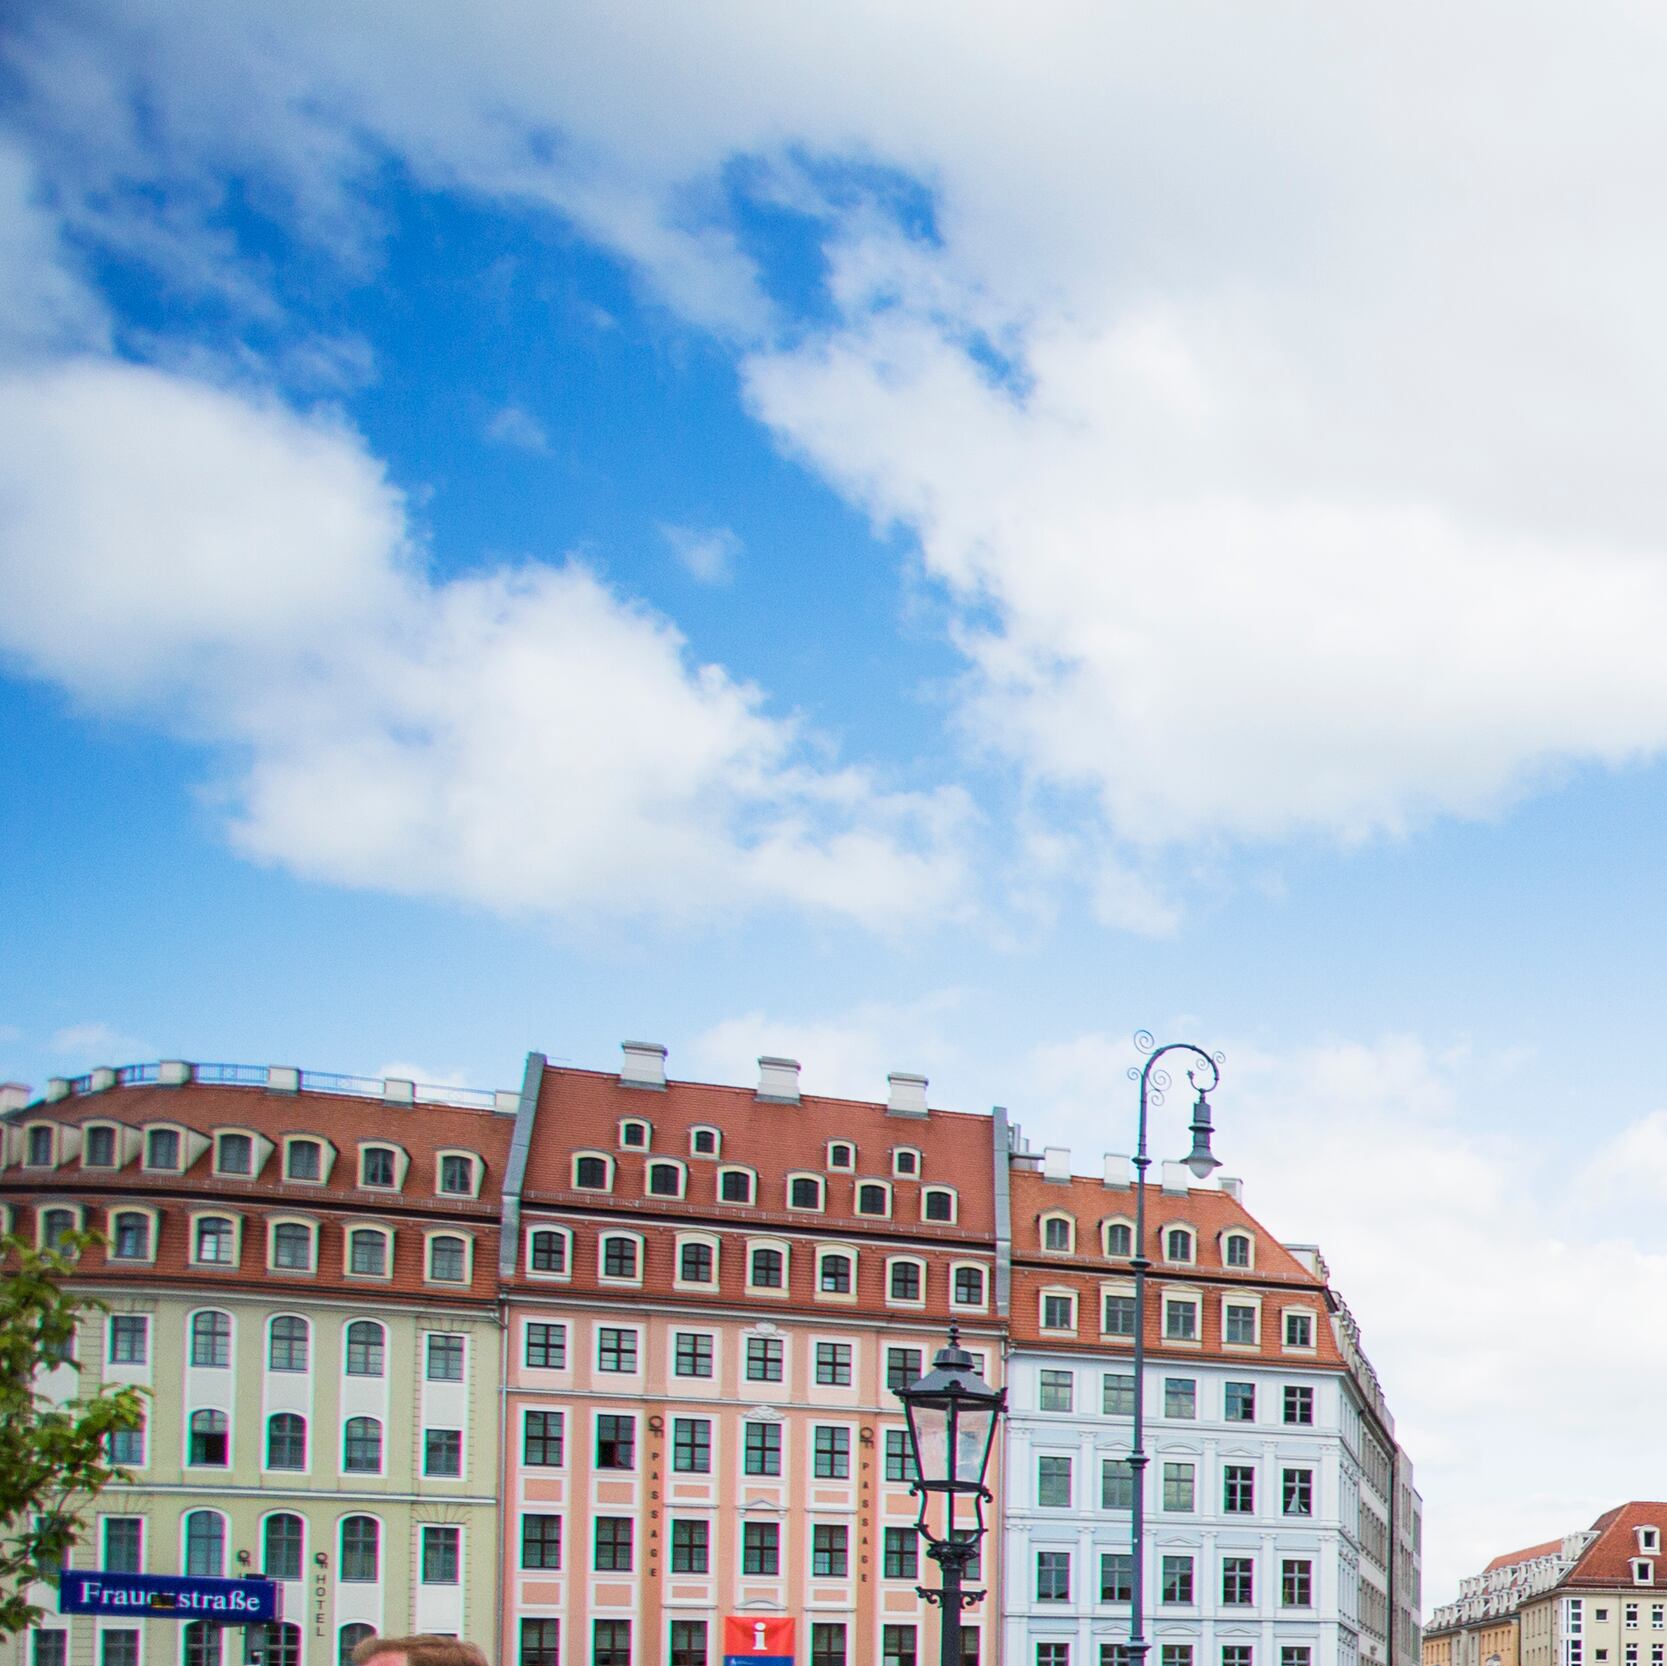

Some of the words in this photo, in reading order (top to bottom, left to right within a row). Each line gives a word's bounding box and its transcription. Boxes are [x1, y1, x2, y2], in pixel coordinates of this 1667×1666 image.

[650, 1452, 659, 1577] PASSAGE
[861, 1461, 870, 1583] PASSAGE
[80, 1581, 261, 1611] Fraustraße
[316, 1574, 327, 1637] HOTEL
